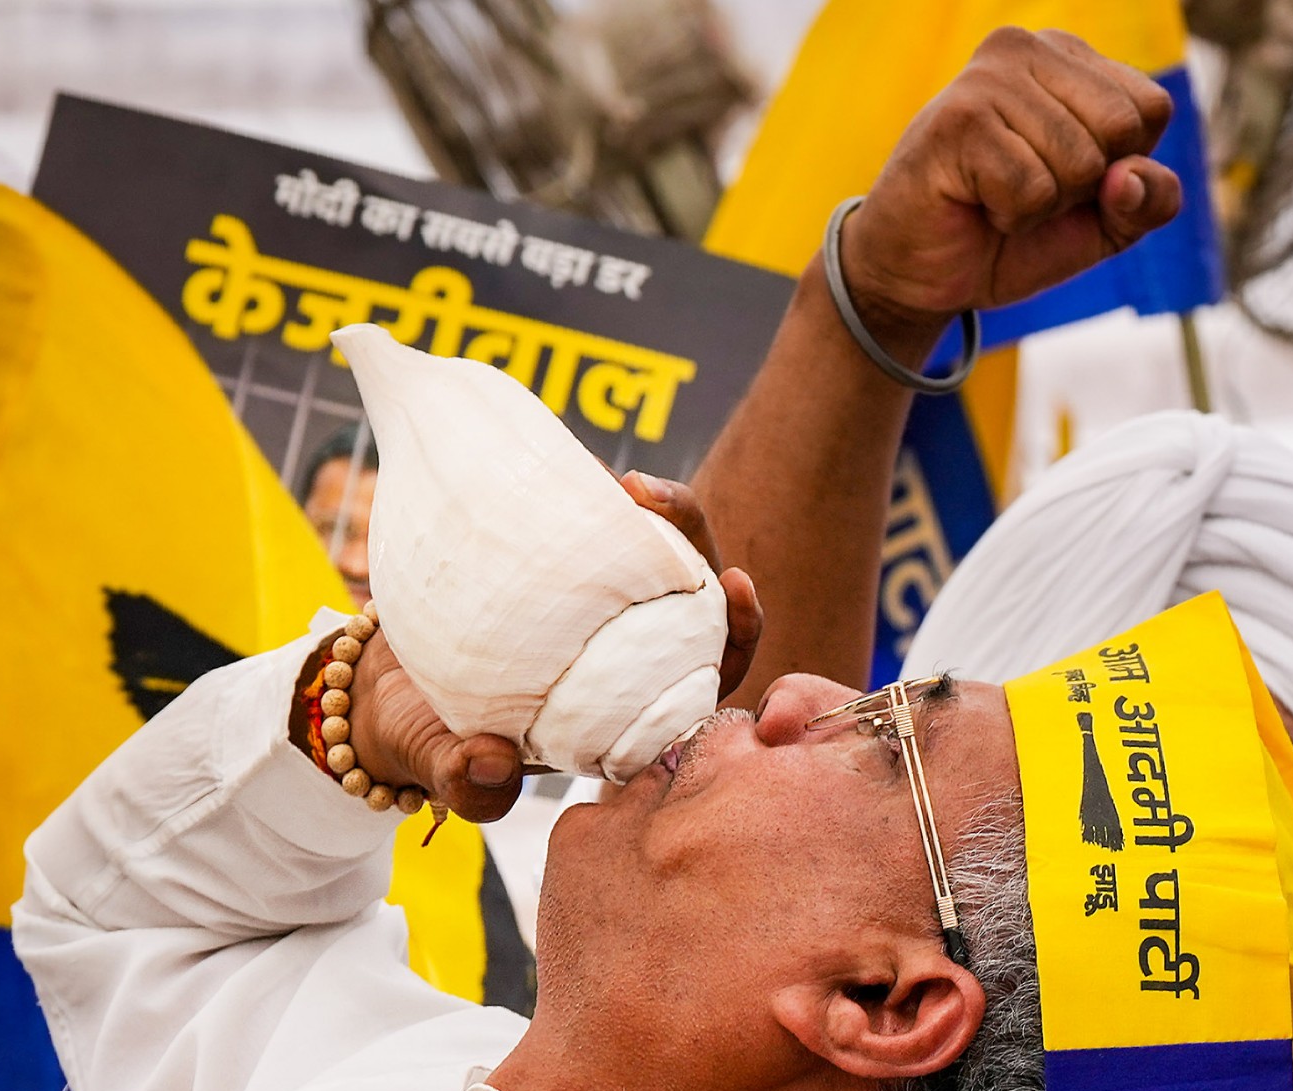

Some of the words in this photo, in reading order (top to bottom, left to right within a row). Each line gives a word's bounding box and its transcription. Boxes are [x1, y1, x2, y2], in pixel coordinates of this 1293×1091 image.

[274, 168, 360, 227] मोदी
[360, 195, 420, 242] का
[420, 209, 521, 268] सबसे
[593, 253, 652, 300] डर
[1097, 643, 1151, 684] आम
[1113, 695, 1195, 853] आदमी
[1136, 868, 1201, 1001] पार्टी
